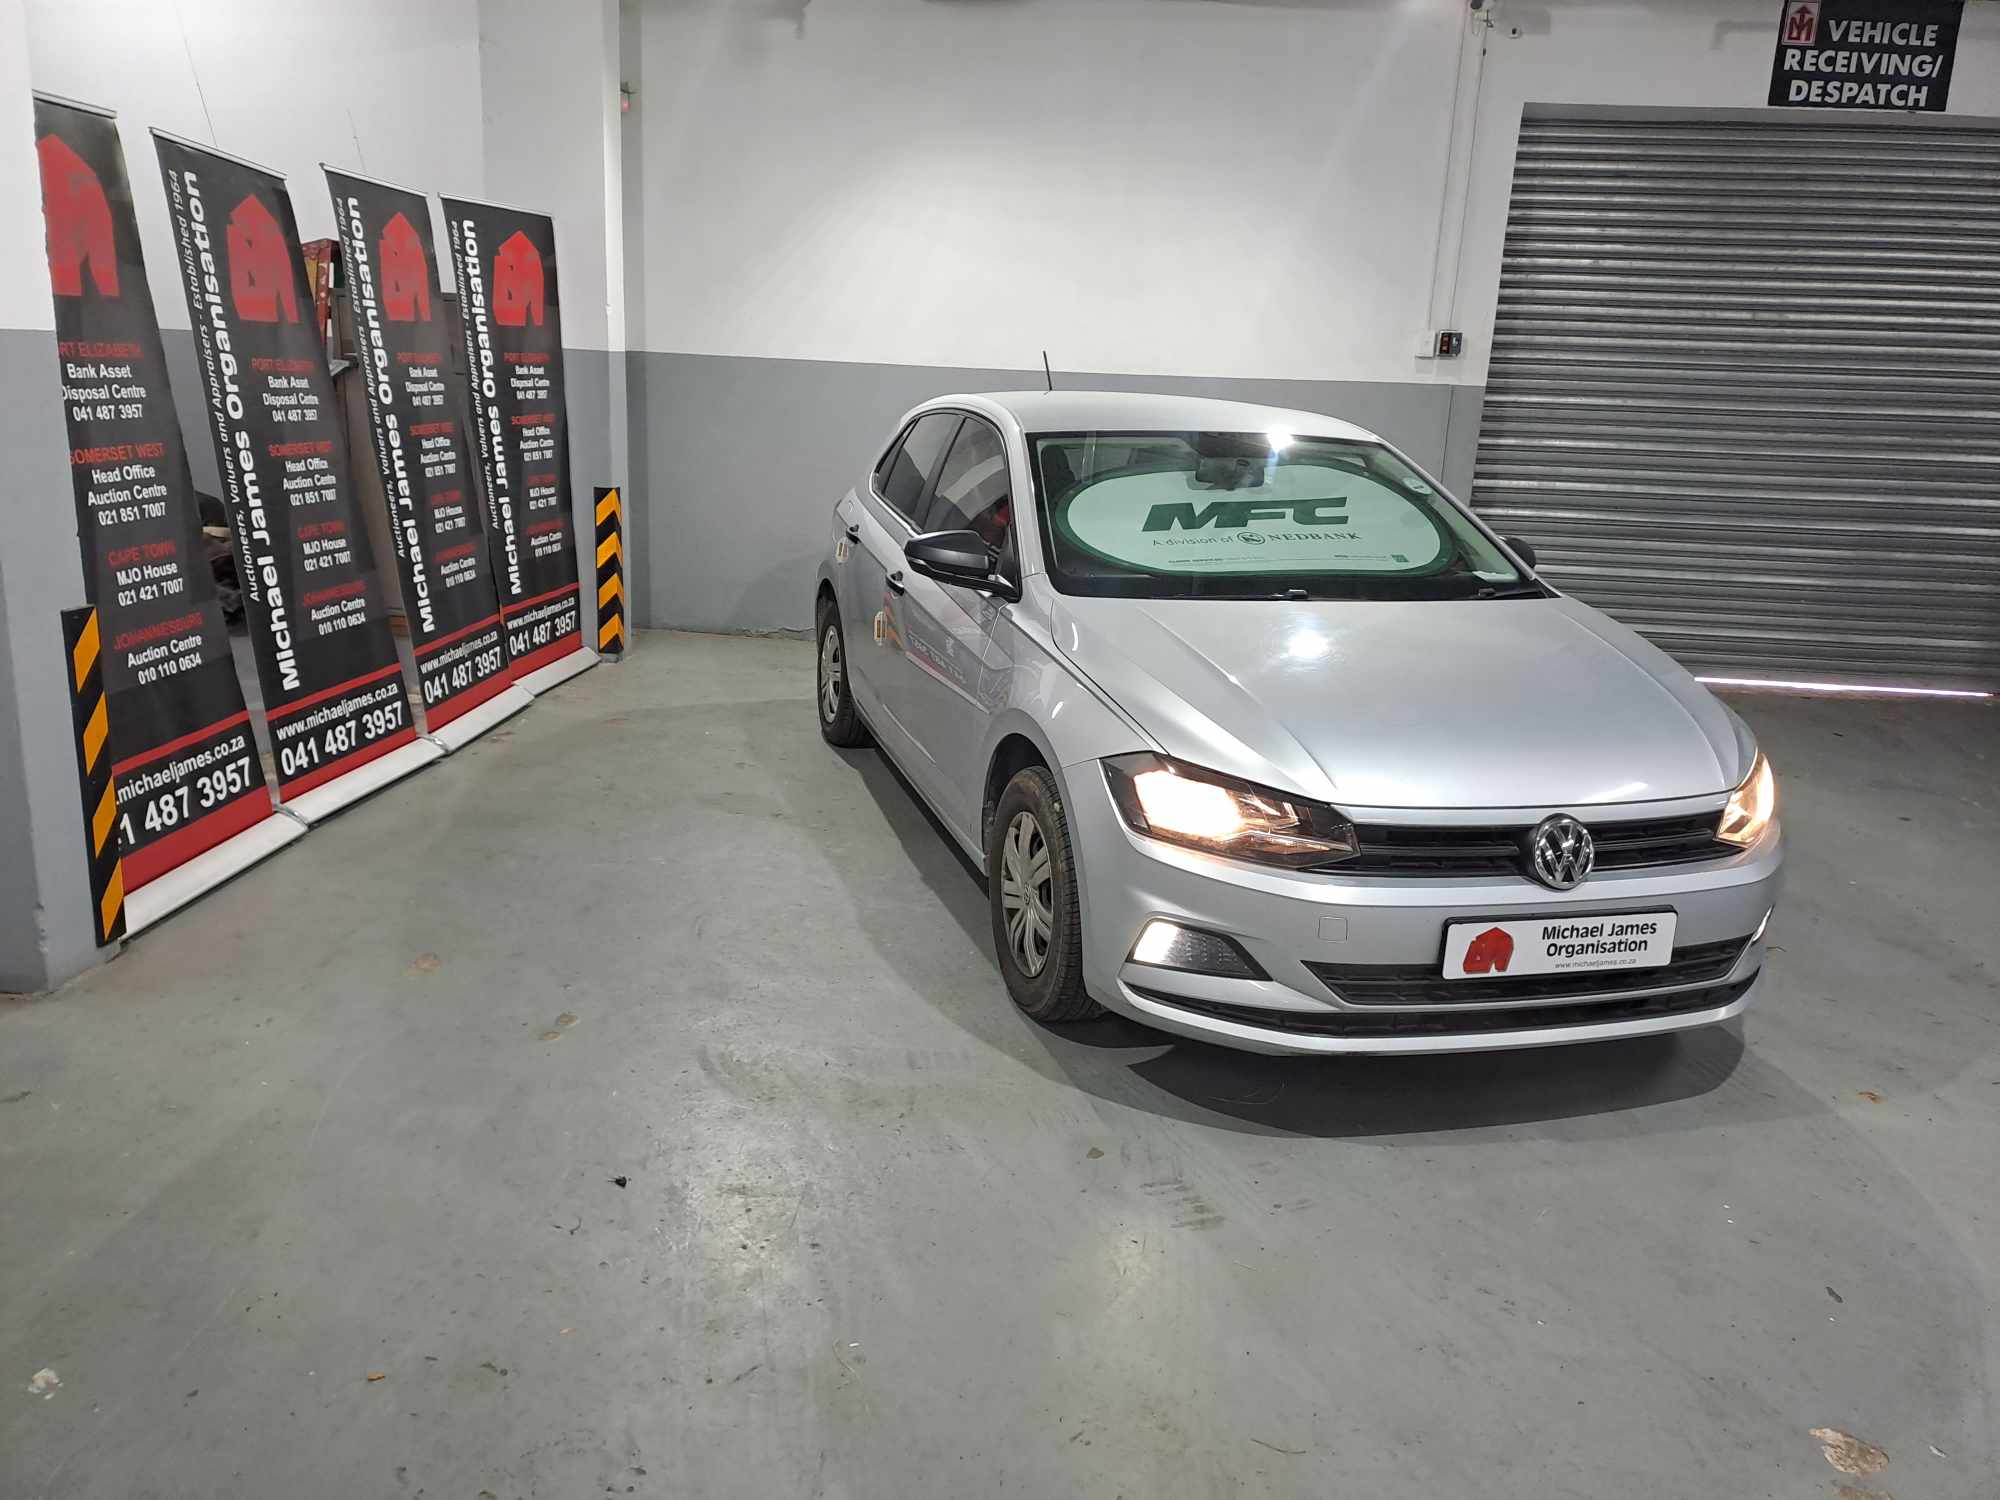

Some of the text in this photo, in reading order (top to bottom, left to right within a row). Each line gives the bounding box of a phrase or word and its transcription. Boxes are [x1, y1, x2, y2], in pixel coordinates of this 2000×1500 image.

[1828, 19, 1939, 47] VEHICLE
[1783, 48, 1944, 78] RECEIVING/
[1788, 79, 1928, 107] DESPATCH
[168, 168, 184, 211] 1964
[176, 214, 203, 309] Established
[66, 363, 132, 378] Bank Asset
[200, 324, 222, 409] Appraisers
[62, 384, 147, 403] Disposal Centre
[267, 375, 289, 388] Bank
[72, 404, 143, 421] 041 487 3957
[262, 393, 298, 407] Disposal
[369, 398, 381, 424] and
[463, 220, 522, 595] Michael James Organisation
[472, 391, 483, 415] and
[214, 411, 228, 442] and
[272, 409, 286, 422] 041
[347, 197, 436, 633] Michael James Organisation
[184, 171, 300, 691] Michael James Organisation
[375, 427, 390, 476] Valuers
[91, 464, 156, 484] Head Office
[223, 446, 240, 504] Valuers
[285, 459, 306, 472] Head
[88, 483, 168, 506] Auction Centre
[283, 476, 314, 490] Auction
[290, 493, 304, 506] 021
[304, 491, 320, 504] 851
[98, 501, 166, 526] 021 851 7007
[1141, 496, 1349, 532] MFC
[321, 538, 347, 551] House
[1165, 536, 1216, 546] division
[1220, 535, 1234, 545] of
[1268, 531, 1361, 542] NEDBANK
[116, 562, 178, 586] MJO House
[304, 558, 318, 572] 021
[319, 554, 333, 568] 421
[117, 577, 184, 607] 021 421 7007
[311, 598, 366, 621] Auction Centre
[318, 622, 333, 636] 010
[333, 617, 347, 631] 110
[509, 610, 576, 656] 041 487 3957
[127, 634, 203, 669] Auction Centre
[138, 652, 202, 685] 010 110 0634
[424, 646, 500, 704] 041 487 3957
[276, 683, 399, 741] www.michaeljames.co.za
[281, 701, 403, 776] 041 487 3957
[116, 735, 246, 806] .michaeljames.co.za
[144, 786, 189, 832] 487
[196, 756, 250, 808] 3957
[1542, 922, 1657, 940] Michael James
[1546, 939, 1648, 958] Organisation
